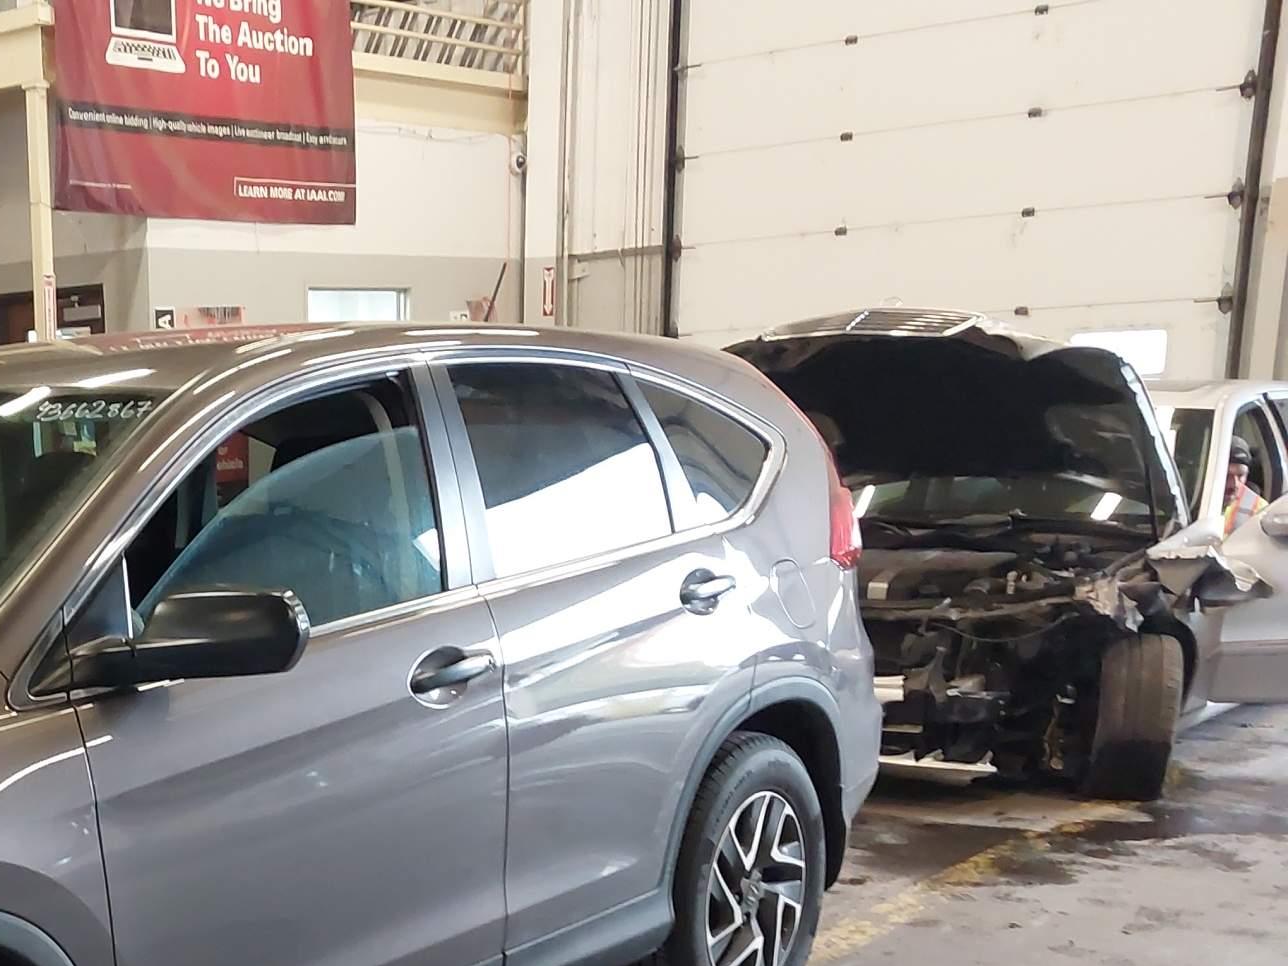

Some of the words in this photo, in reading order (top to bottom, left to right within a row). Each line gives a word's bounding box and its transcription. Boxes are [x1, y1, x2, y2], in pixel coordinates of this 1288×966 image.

[195, 14, 232, 45] The
[237, 21, 314, 57] Auction
[195, 50, 221, 79] To
[225, 53, 261, 83] You
[124, 113, 149, 129] bidding
[207, 123, 231, 138] images
[238, 184, 268, 199] LEARN
[269, 186, 293, 200] MORE
[294, 188, 306, 201] AT
[36, 400, 152, 422] 43662867
